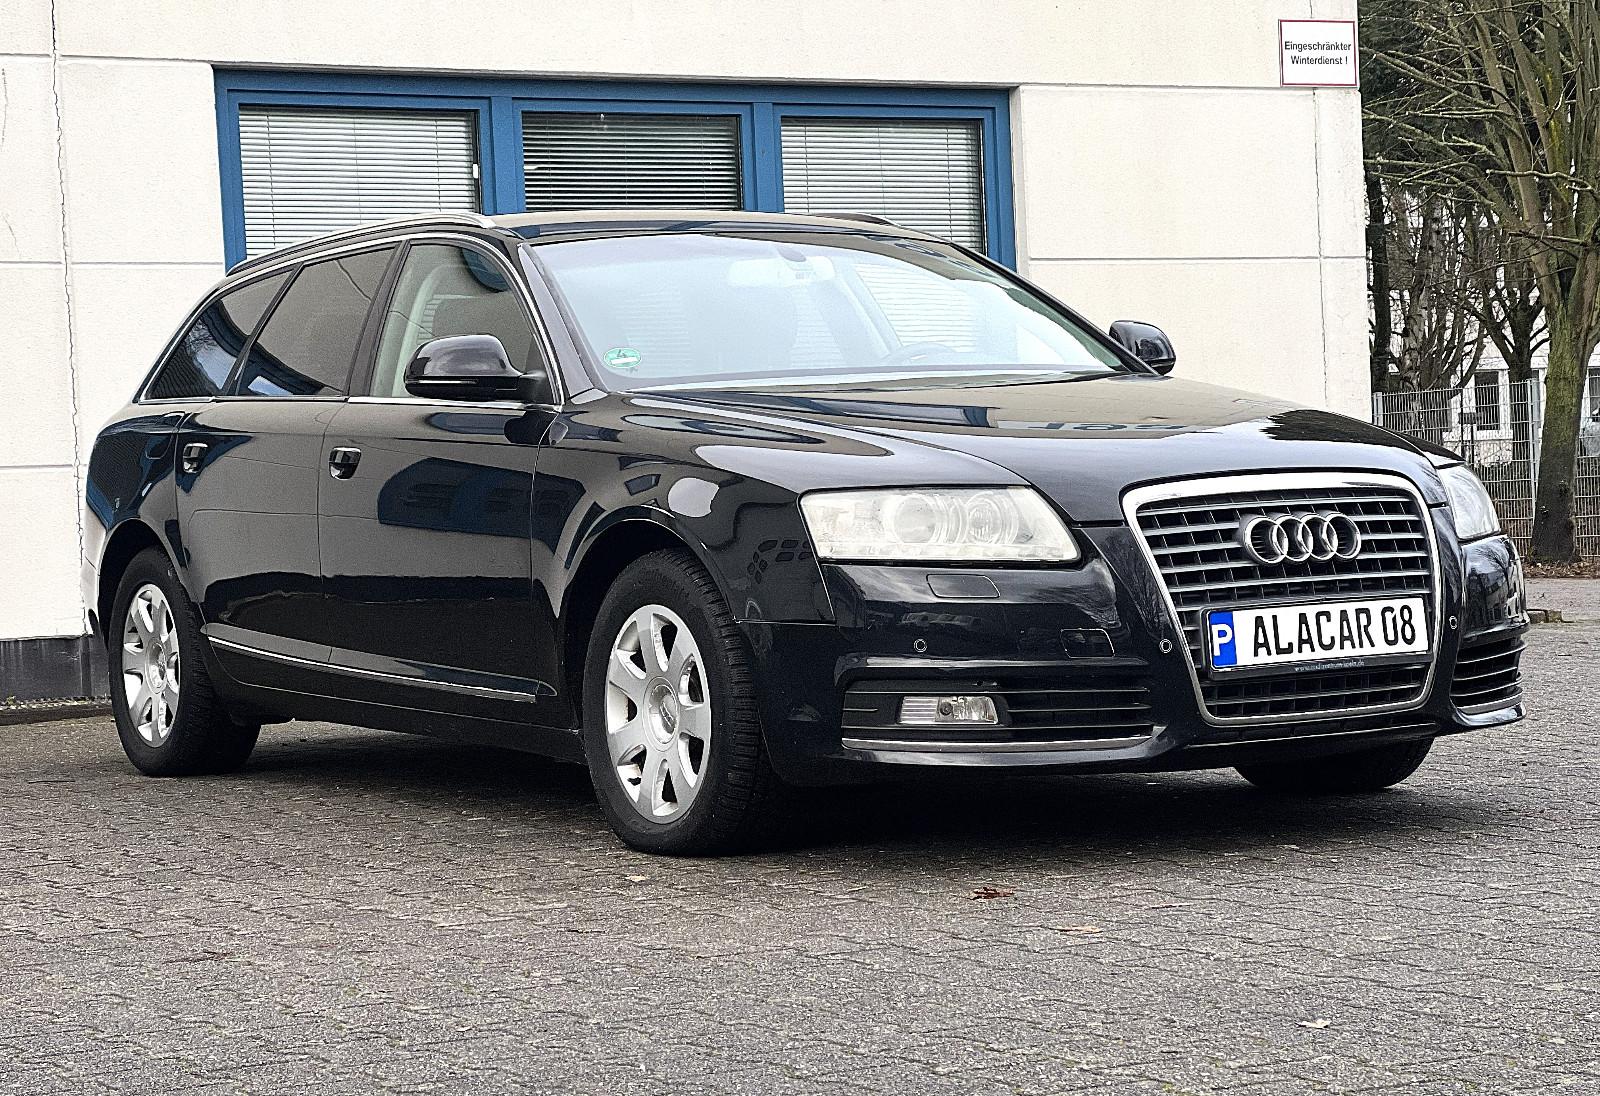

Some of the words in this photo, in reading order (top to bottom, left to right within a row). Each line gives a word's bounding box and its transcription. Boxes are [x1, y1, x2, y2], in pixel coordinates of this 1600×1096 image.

[1284, 40, 1352, 53] Eingeschränkter
[1290, 55, 1343, 65] Winterdienst
[1211, 624, 1233, 657] P
[1253, 607, 1375, 657] ALACAR
[1380, 604, 1416, 646] 08
